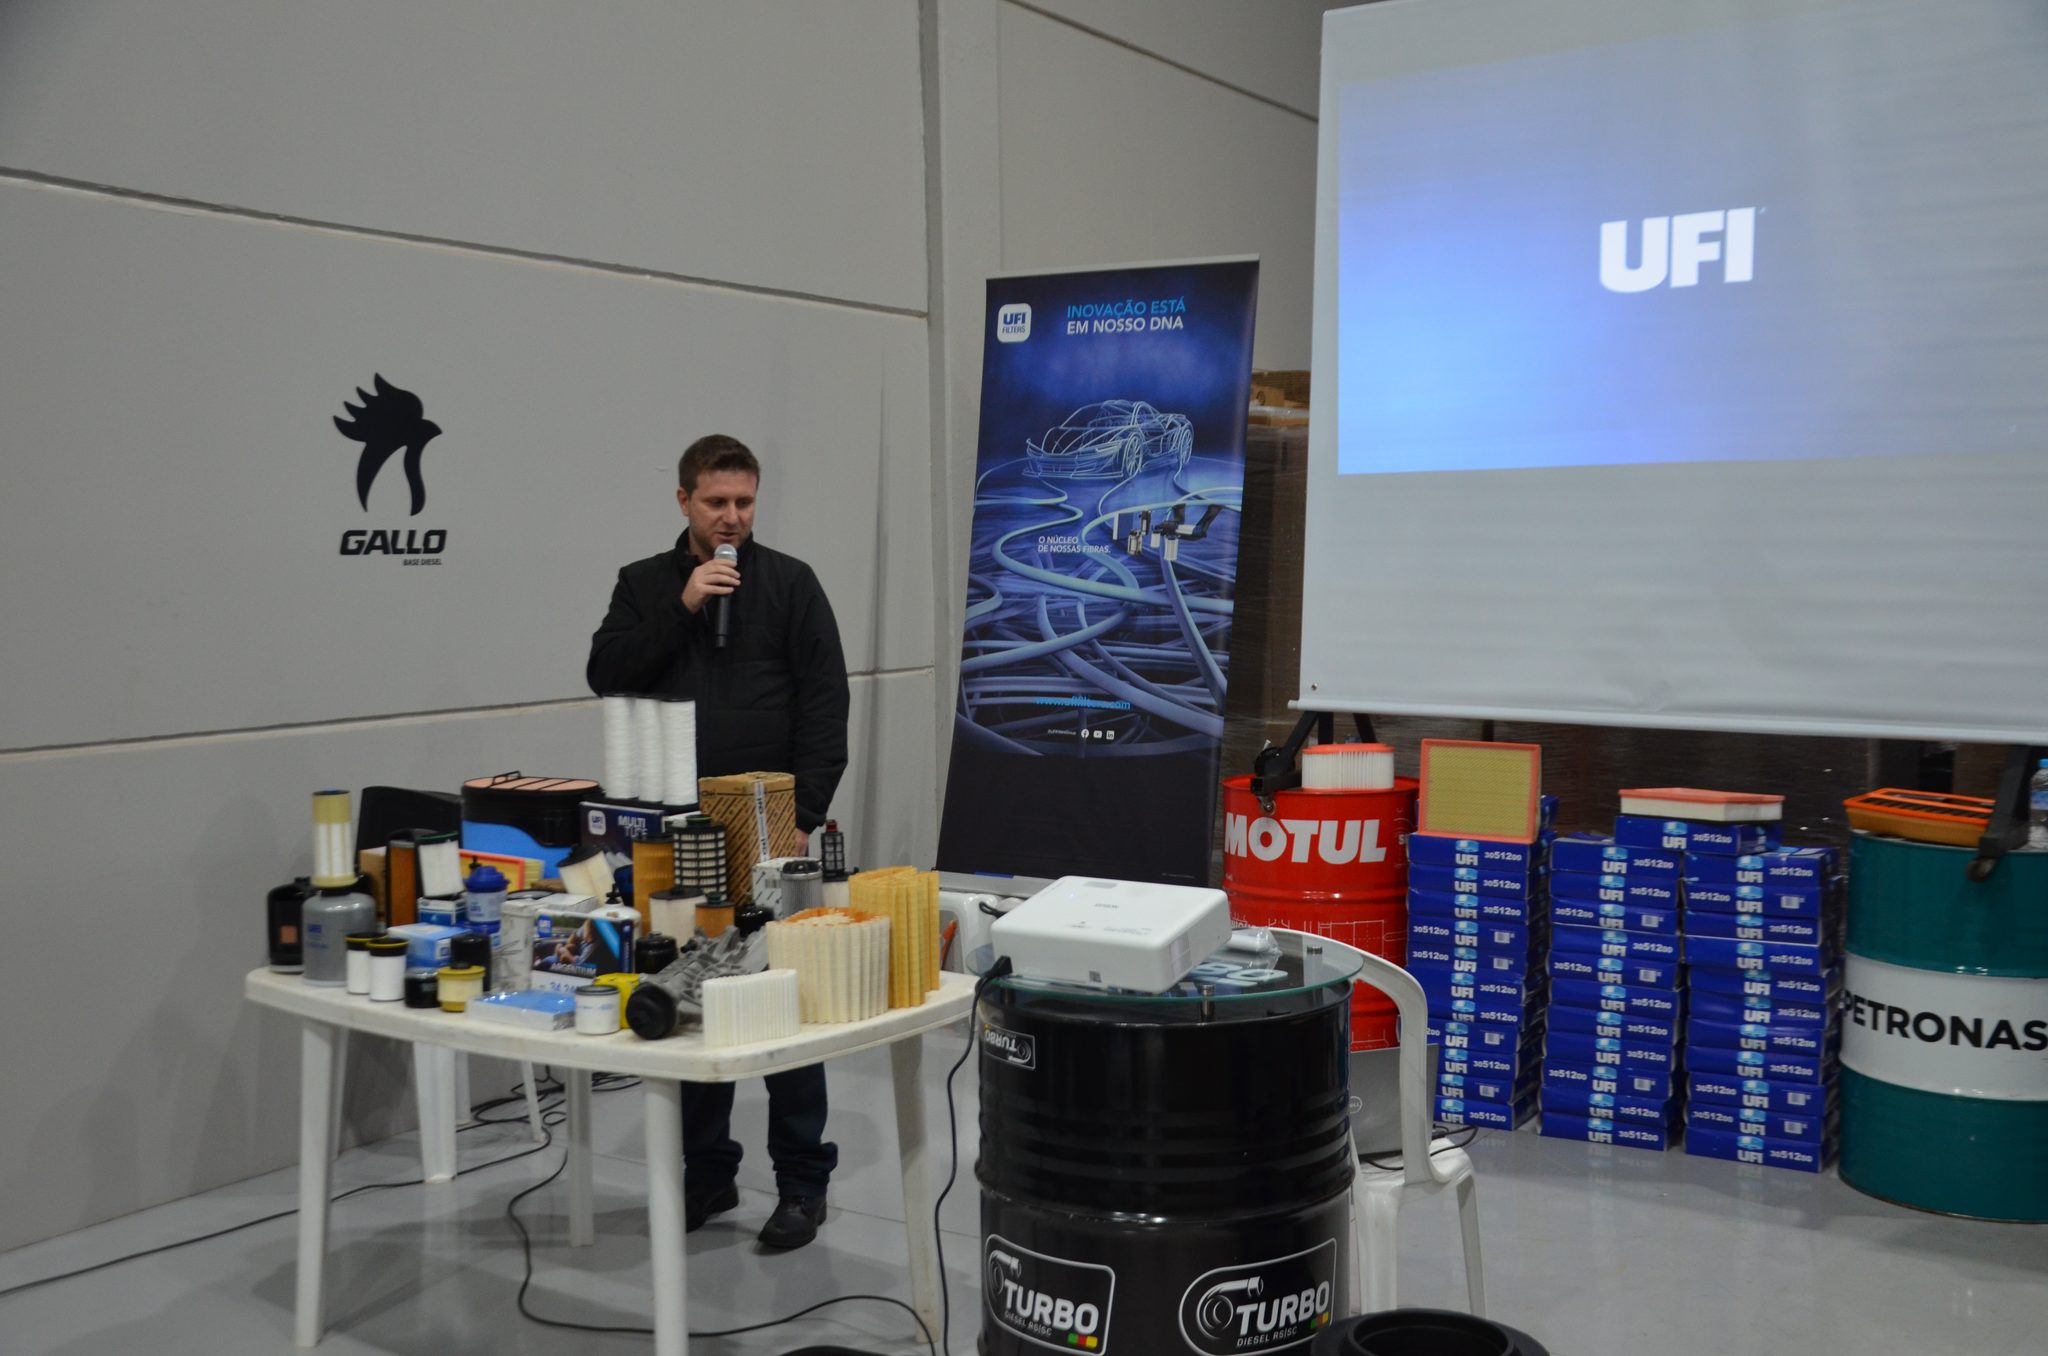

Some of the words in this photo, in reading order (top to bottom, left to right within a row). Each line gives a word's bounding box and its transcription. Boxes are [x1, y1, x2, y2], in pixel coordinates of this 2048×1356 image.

[1600, 206, 1756, 293] UFI
[1066, 299, 1147, 320] INOVAÇÃO
[1150, 296, 1186, 314] ESTÁ
[1003, 312, 1026, 325] UFI
[1066, 320, 1088, 335] EM
[1092, 318, 1146, 333] NOSSO
[1149, 315, 1184, 331] DNA
[339, 529, 447, 556] GALLO
[1038, 536, 1046, 544] O
[1037, 544, 1049, 553] DE
[1049, 544, 1081, 553] NOSSAS
[1224, 812, 1387, 865] MOTUL
[1662, 836, 1688, 849] UFI
[1455, 853, 1479, 866] UFI
[1602, 860, 1627, 874] UFI
[1736, 870, 1763, 883] UFI
[1454, 881, 1477, 893] UFI
[1599, 888, 1624, 902] UFI
[1454, 907, 1477, 919] UFI
[1736, 900, 1763, 913] UFI
[1736, 927, 1763, 939] UFI
[1455, 934, 1478, 947] UFI
[1601, 943, 1626, 957] UFI
[1453, 960, 1477, 973] UFI
[1736, 957, 1763, 970] UFI
[1597, 972, 1622, 984] UFI
[1451, 986, 1474, 999] UFI
[1743, 981, 1771, 996] UFI
[1744, 1009, 1771, 1023] UFI
[1843, 989, 2048, 1051] PETRONAS
[1596, 1025, 1621, 1038] UFI
[985, 1030, 1017, 1052] TURBO
[1445, 1035, 1469, 1048] UFI
[1740, 1038, 1766, 1050] UFI
[1595, 1052, 1620, 1065] UFI
[1445, 1061, 1467, 1074] UFI
[1737, 1065, 1763, 1078] UFI
[1441, 1086, 1464, 1099] UFI
[1592, 1079, 1617, 1093] UFI
[1742, 1094, 1769, 1109] UFI
[1441, 1112, 1464, 1124] UFI
[1589, 1107, 1614, 1119] UFI
[1739, 1122, 1766, 1136] UFI
[1588, 1131, 1612, 1144] UFI
[1737, 1150, 1763, 1164] UFI
[1004, 1278, 1099, 1335] TURBO
[1236, 1280, 1330, 1336] TURBO
[1004, 1310, 1026, 1327] DIESEL
[1236, 1334, 1270, 1347] DIESEL
